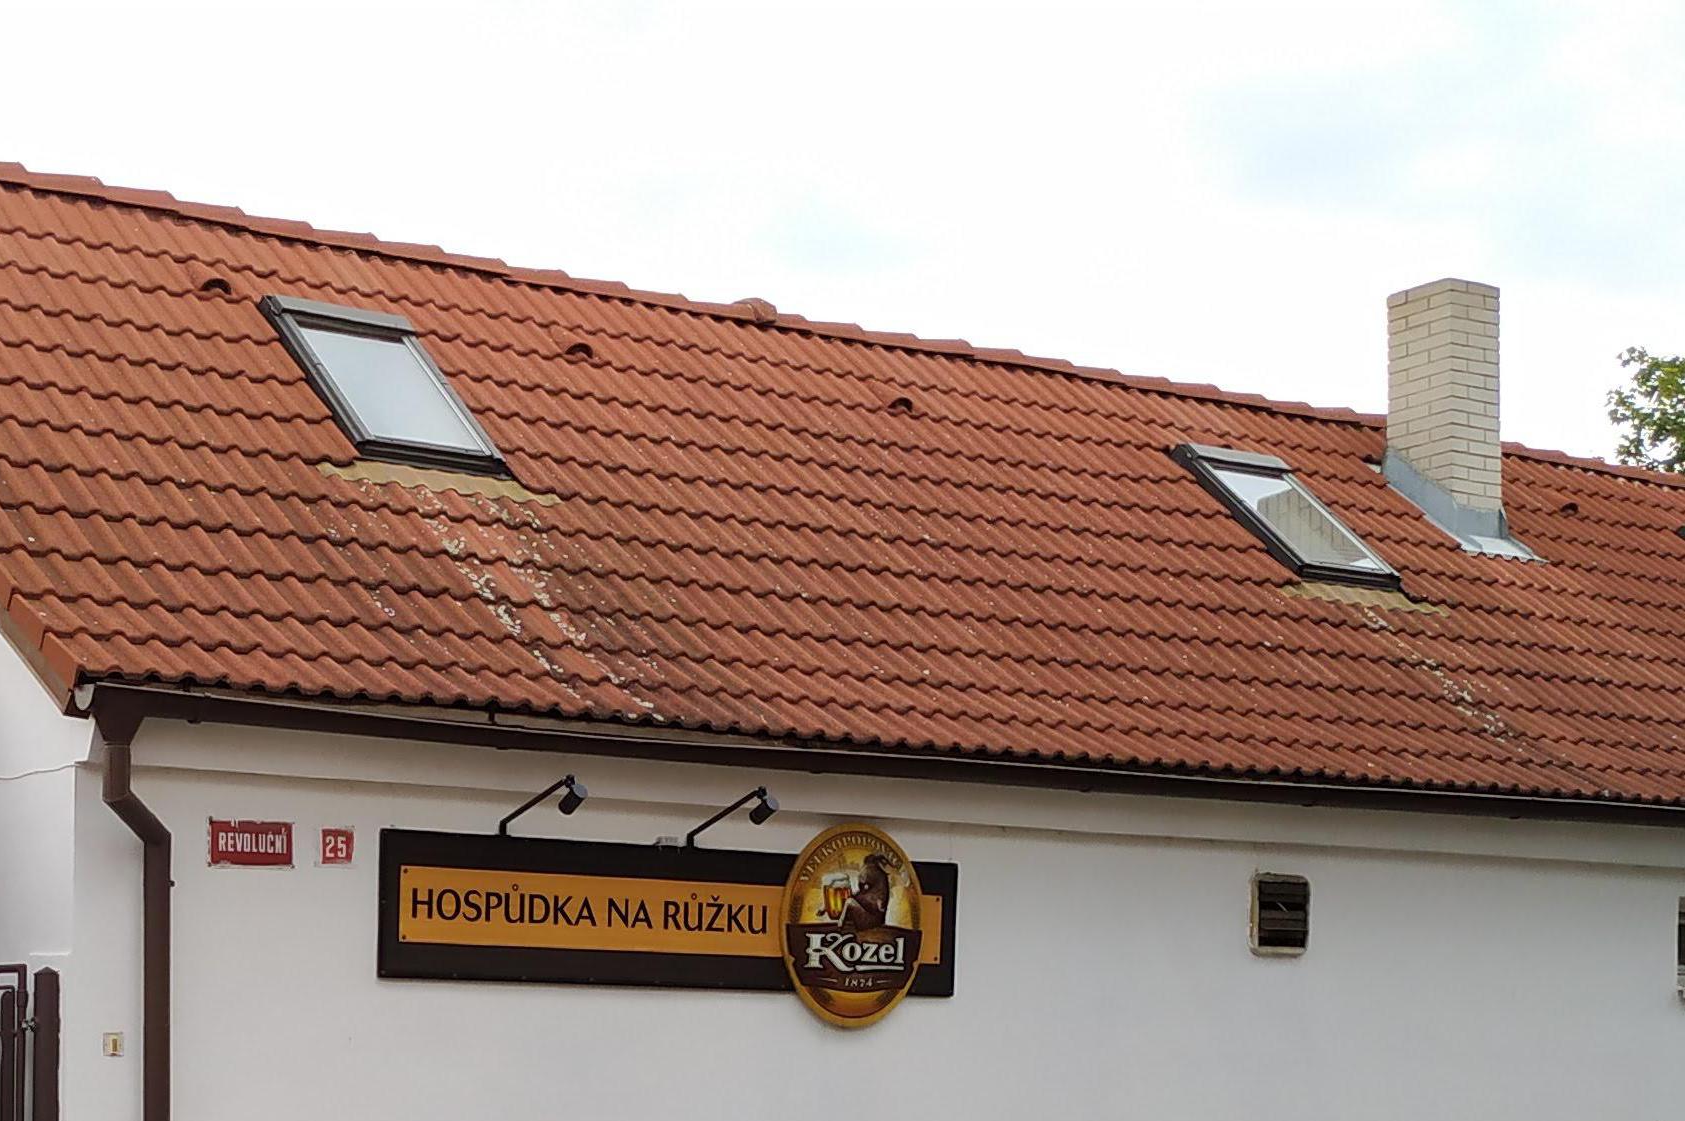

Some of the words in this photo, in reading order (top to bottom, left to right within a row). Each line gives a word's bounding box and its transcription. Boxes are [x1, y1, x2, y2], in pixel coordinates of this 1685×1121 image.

[218, 828, 287, 854] REVOLUČNÍ
[325, 836, 347, 858] 25
[411, 883, 597, 927] HOSPŮDKA
[607, 897, 653, 929] NA
[663, 892, 768, 934] RŮŽKU
[803, 932, 905, 972] Kozel
[844, 976, 873, 988] 1874
